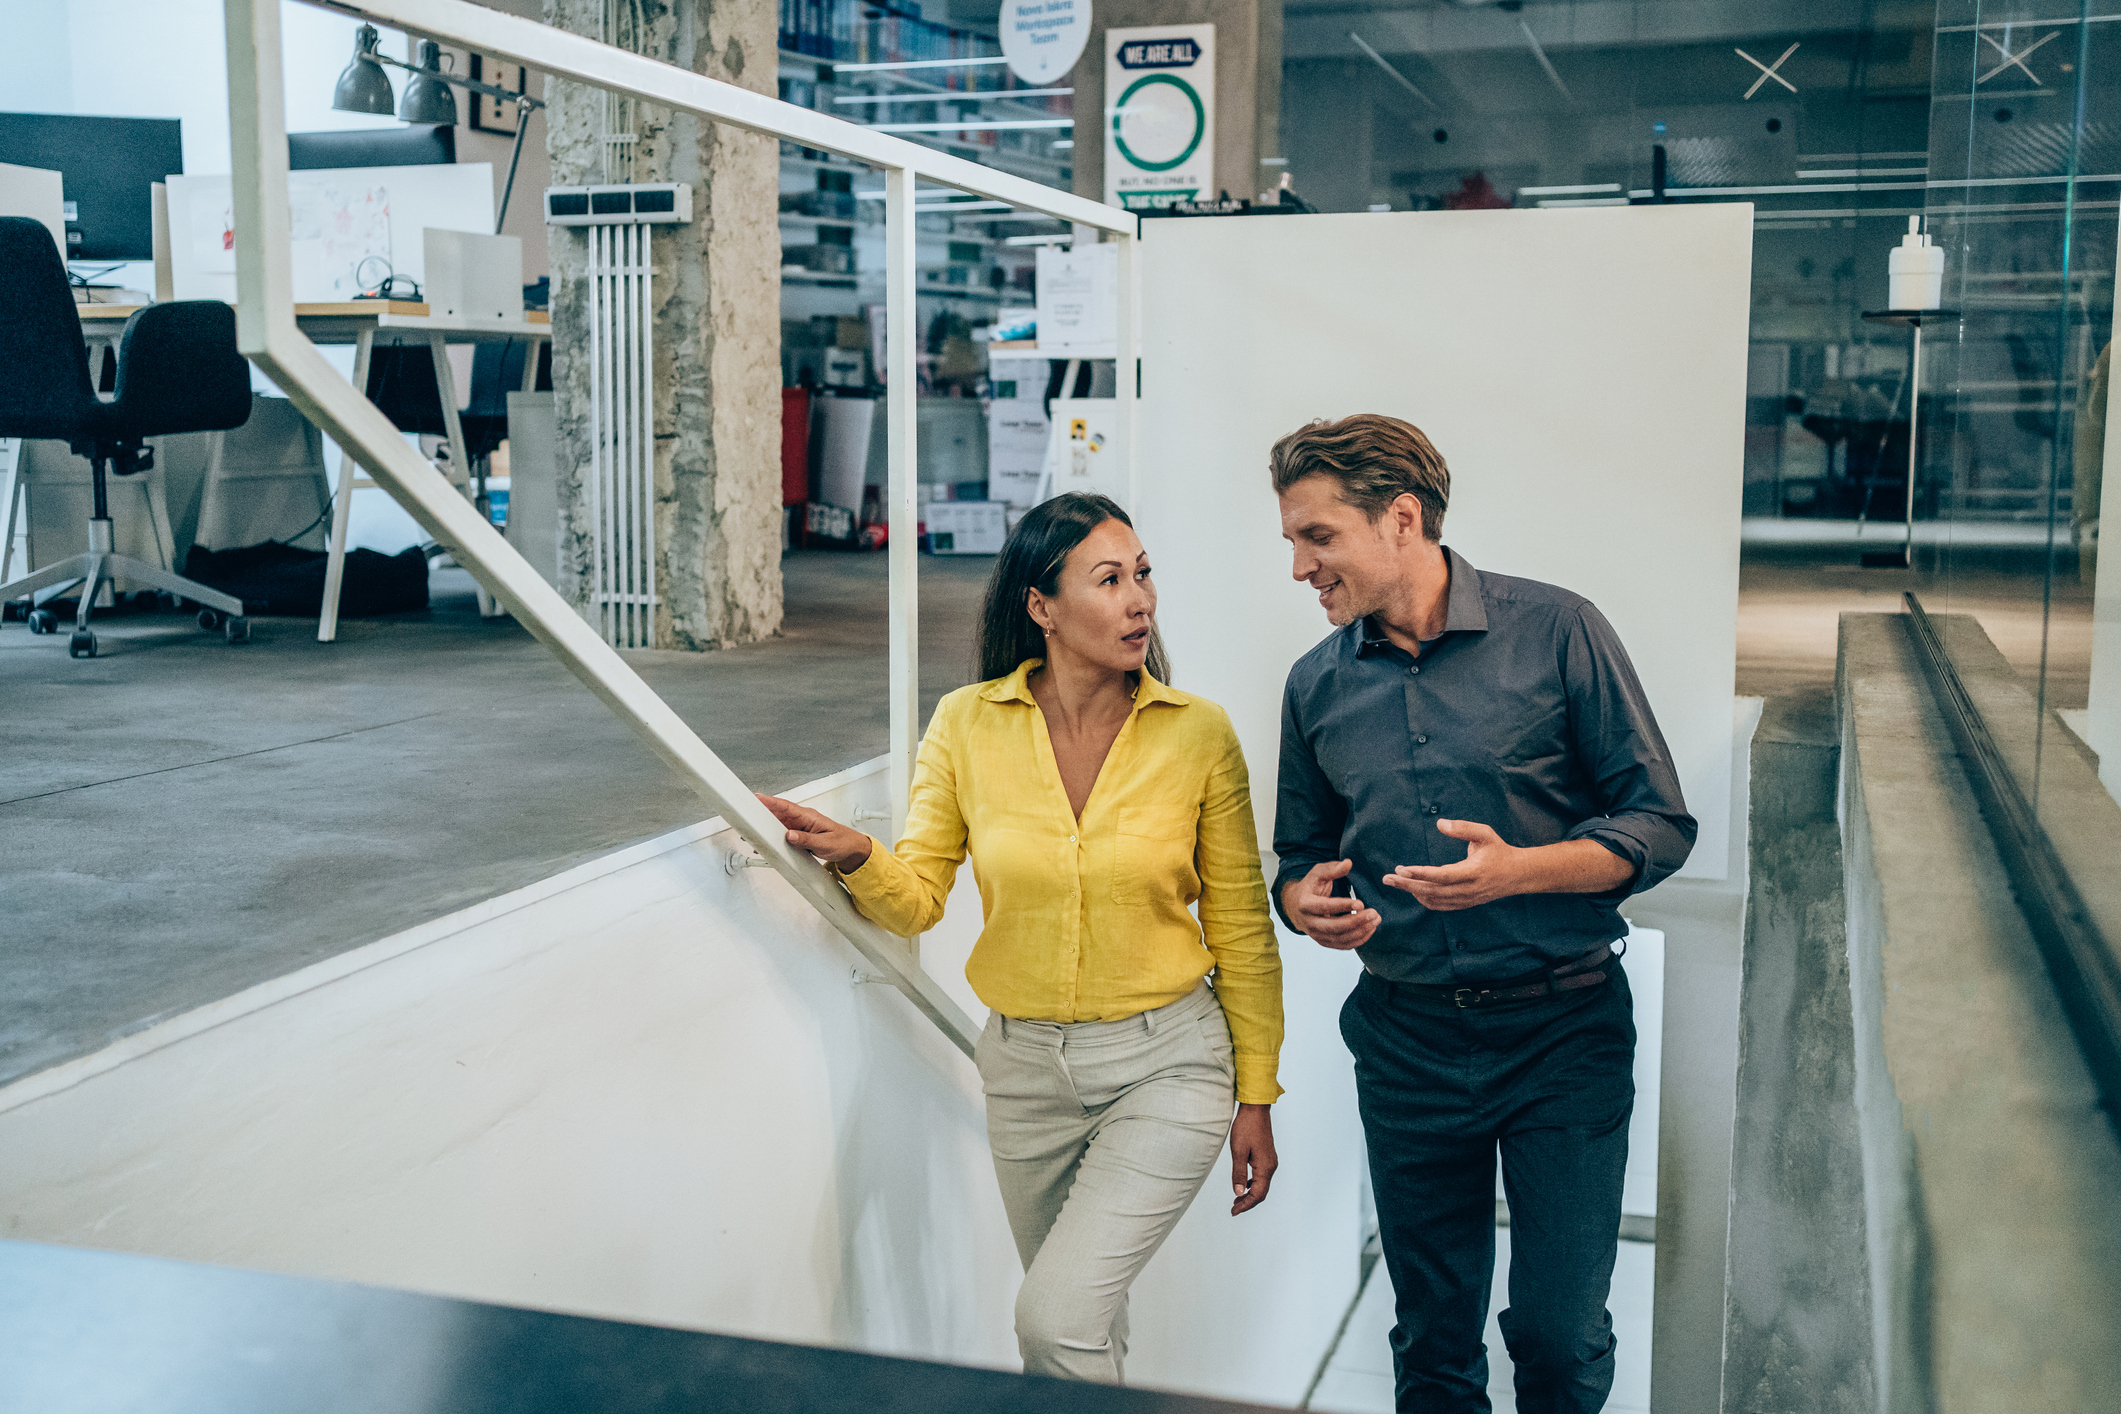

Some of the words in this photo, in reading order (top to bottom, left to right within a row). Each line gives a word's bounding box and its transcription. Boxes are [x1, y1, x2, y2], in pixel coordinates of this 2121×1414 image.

[1015, 16, 1074, 31] Workspace
[1029, 32, 1058, 44] Team
[1124, 45, 1145, 64] WE
[1145, 44, 1171, 63] ARE
[1171, 43, 1196, 62] ALL
